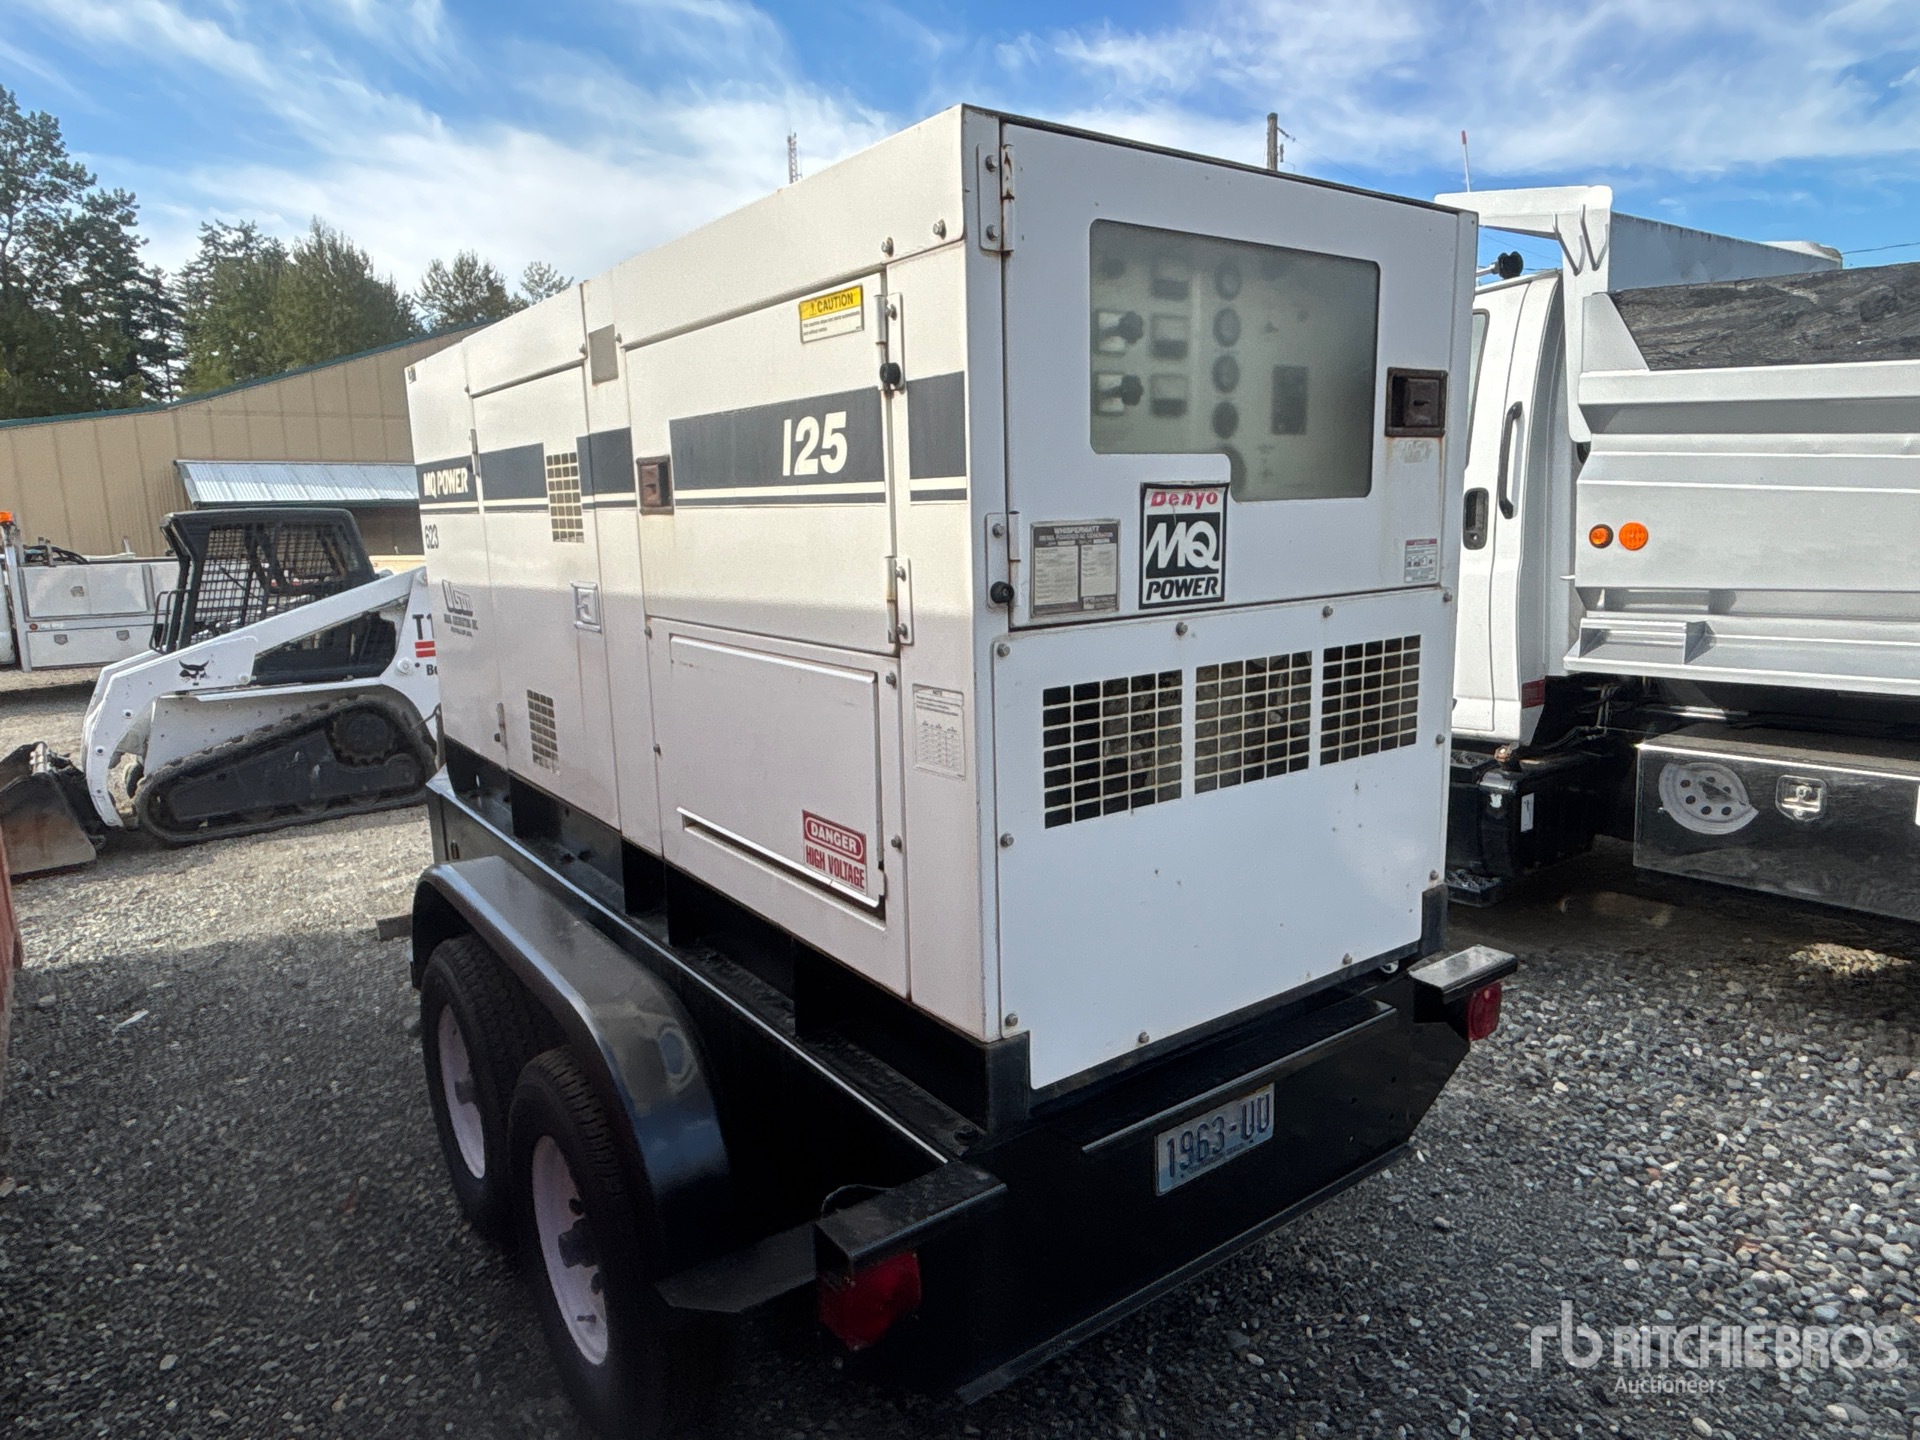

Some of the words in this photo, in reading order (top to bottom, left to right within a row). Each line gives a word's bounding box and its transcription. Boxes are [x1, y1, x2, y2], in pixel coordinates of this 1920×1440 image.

[817, 292, 854, 313] CAUTION
[782, 410, 848, 477] 125
[423, 471, 437, 499] MQ
[437, 467, 468, 495] POWER
[1150, 490, 1219, 510] Denyo
[424, 523, 440, 550] 623
[1145, 520, 1220, 570] MQ
[1145, 576, 1219, 601] POWER
[810, 821, 858, 854] DANGER
[806, 844, 826, 872] HIGH
[827, 853, 865, 890] VOLTAGE
